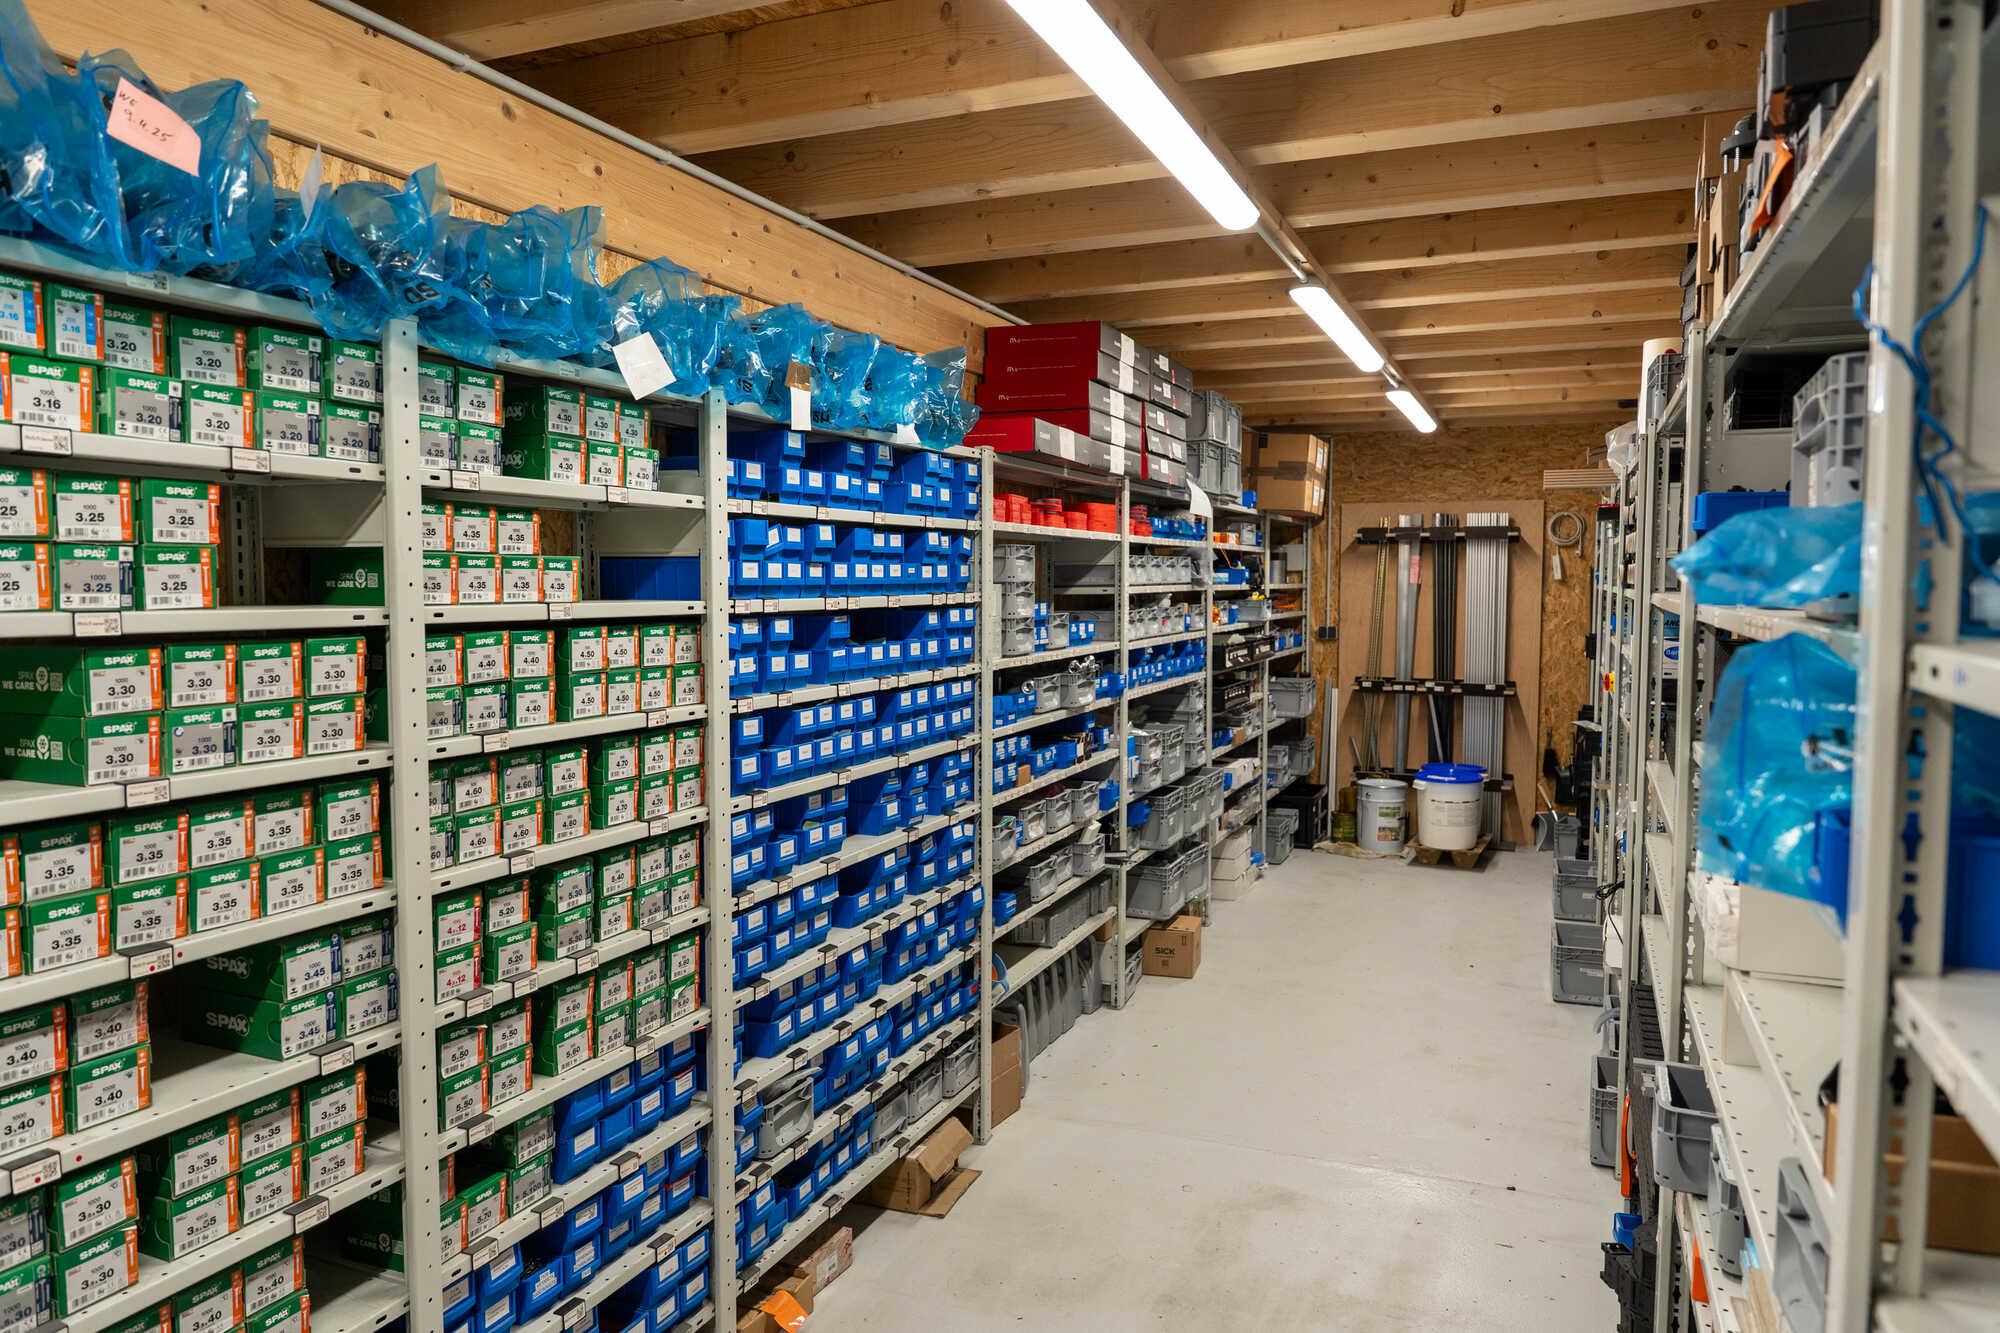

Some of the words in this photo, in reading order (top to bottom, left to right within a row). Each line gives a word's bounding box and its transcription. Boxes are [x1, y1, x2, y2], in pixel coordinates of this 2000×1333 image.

[61, 289, 88, 300] SPAX
[104, 309, 136, 321] SPAX
[192, 329, 221, 339] SPAX
[273, 335, 299, 345] SPAX
[343, 347, 366, 358] SPAX
[28, 365, 64, 379] SPAX
[128, 378, 159, 391] SPAX
[204, 390, 230, 401] SPAX
[273, 400, 299, 410] SPAX
[337, 408, 360, 418] SPAX
[72, 481, 105, 492] SPAX
[166, 486, 196, 497] SPAX
[74, 549, 106, 559] SPAX
[158, 552, 188, 563] SPAX
[185, 649, 213, 659] SPAX
[254, 648, 280, 658] SPAX
[323, 645, 346, 653] SPAX
[104, 654, 136, 665] SPAX
[15, 681, 34, 690] CARE
[184, 711, 213, 723] SPAX
[256, 708, 281, 718] SPAX
[104, 722, 135, 733] SPAX
[17, 749, 36, 758] CARE
[338, 789, 360, 798] SPAX
[204, 810, 231, 821] SPAX
[135, 821, 164, 832] SPAX
[41, 834, 73, 848] SPAX
[339, 845, 363, 855] SPAX
[278, 858, 304, 870] SPAX
[210, 871, 239, 883] SPAX
[132, 887, 163, 899] SPAX
[48, 905, 80, 919] SPAX
[296, 941, 320, 953] SPAX
[1155, 947, 1176, 955] SICK
[207, 957, 249, 979] SPAX
[356, 979, 379, 991] SPAX
[92, 994, 120, 1008] SPAX
[291, 999, 317, 1012] SPAX
[3, 1018, 37, 1034] SPAX
[206, 1012, 249, 1037] SPAX
[92, 1060, 123, 1077] SPAX
[187, 1129, 215, 1145] SPAX
[321, 1135, 344, 1149] SPAX
[255, 1160, 281, 1176] SPAX
[76, 1171, 108, 1192] SPAX
[186, 1188, 215, 1208] SPAX
[80, 1240, 111, 1260] SPAX
[266, 1308, 289, 1327] SPAX
